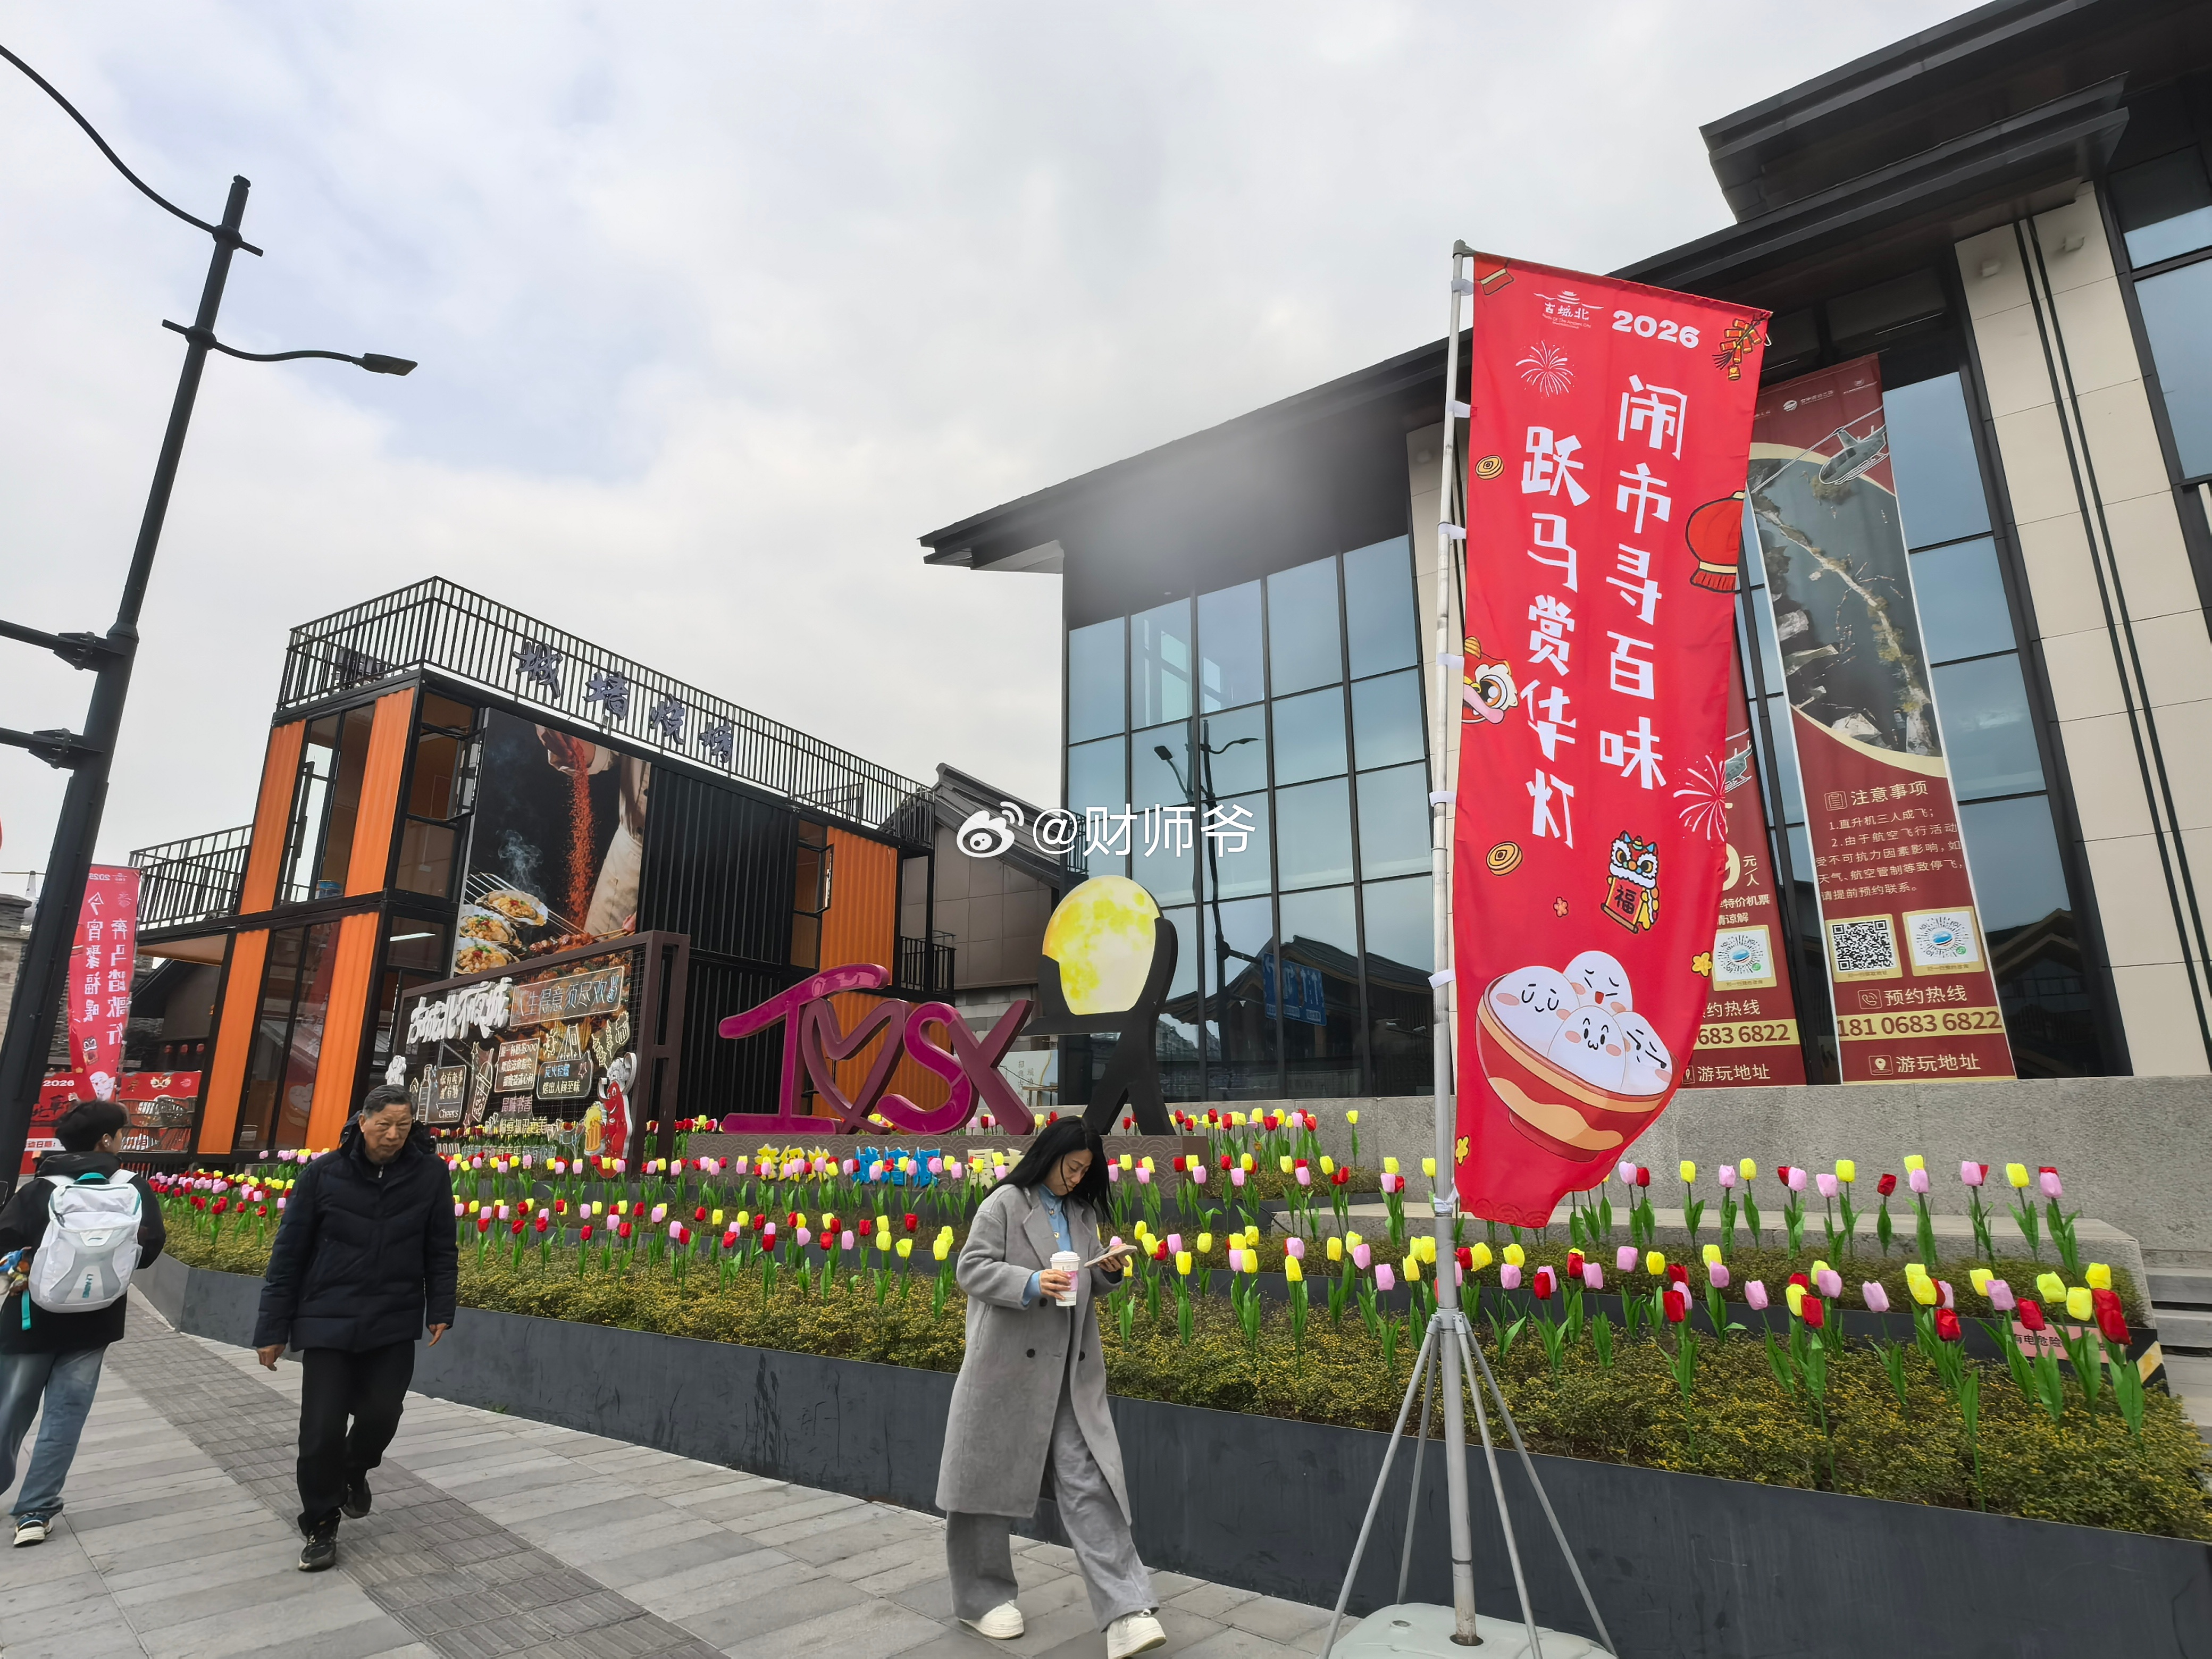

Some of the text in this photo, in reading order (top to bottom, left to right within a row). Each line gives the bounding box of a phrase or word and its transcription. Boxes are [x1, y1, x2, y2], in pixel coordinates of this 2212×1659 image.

[1544, 301, 1590, 320] 古城北
[1611, 309, 1700, 349] 2026
[1599, 374, 1687, 790] 闹市寻百味
[1520, 426, 1590, 849] 跃马赏华灯
[1850, 781, 1929, 806] 注意事项
[1831, 823, 1957, 847] 2.由于航空飞行活动
[1614, 884, 1637, 915] 福
[1884, 985, 1967, 1006] 预约热线
[1702, 999, 1761, 1018] 约热线
[1738, 1024, 1790, 1043] 6822
[1837, 1011, 2002, 1037] 181 0683 6822
[1697, 1063, 1771, 1082] 游玩地址
[1896, 1053, 1981, 1073] 游玩地址
